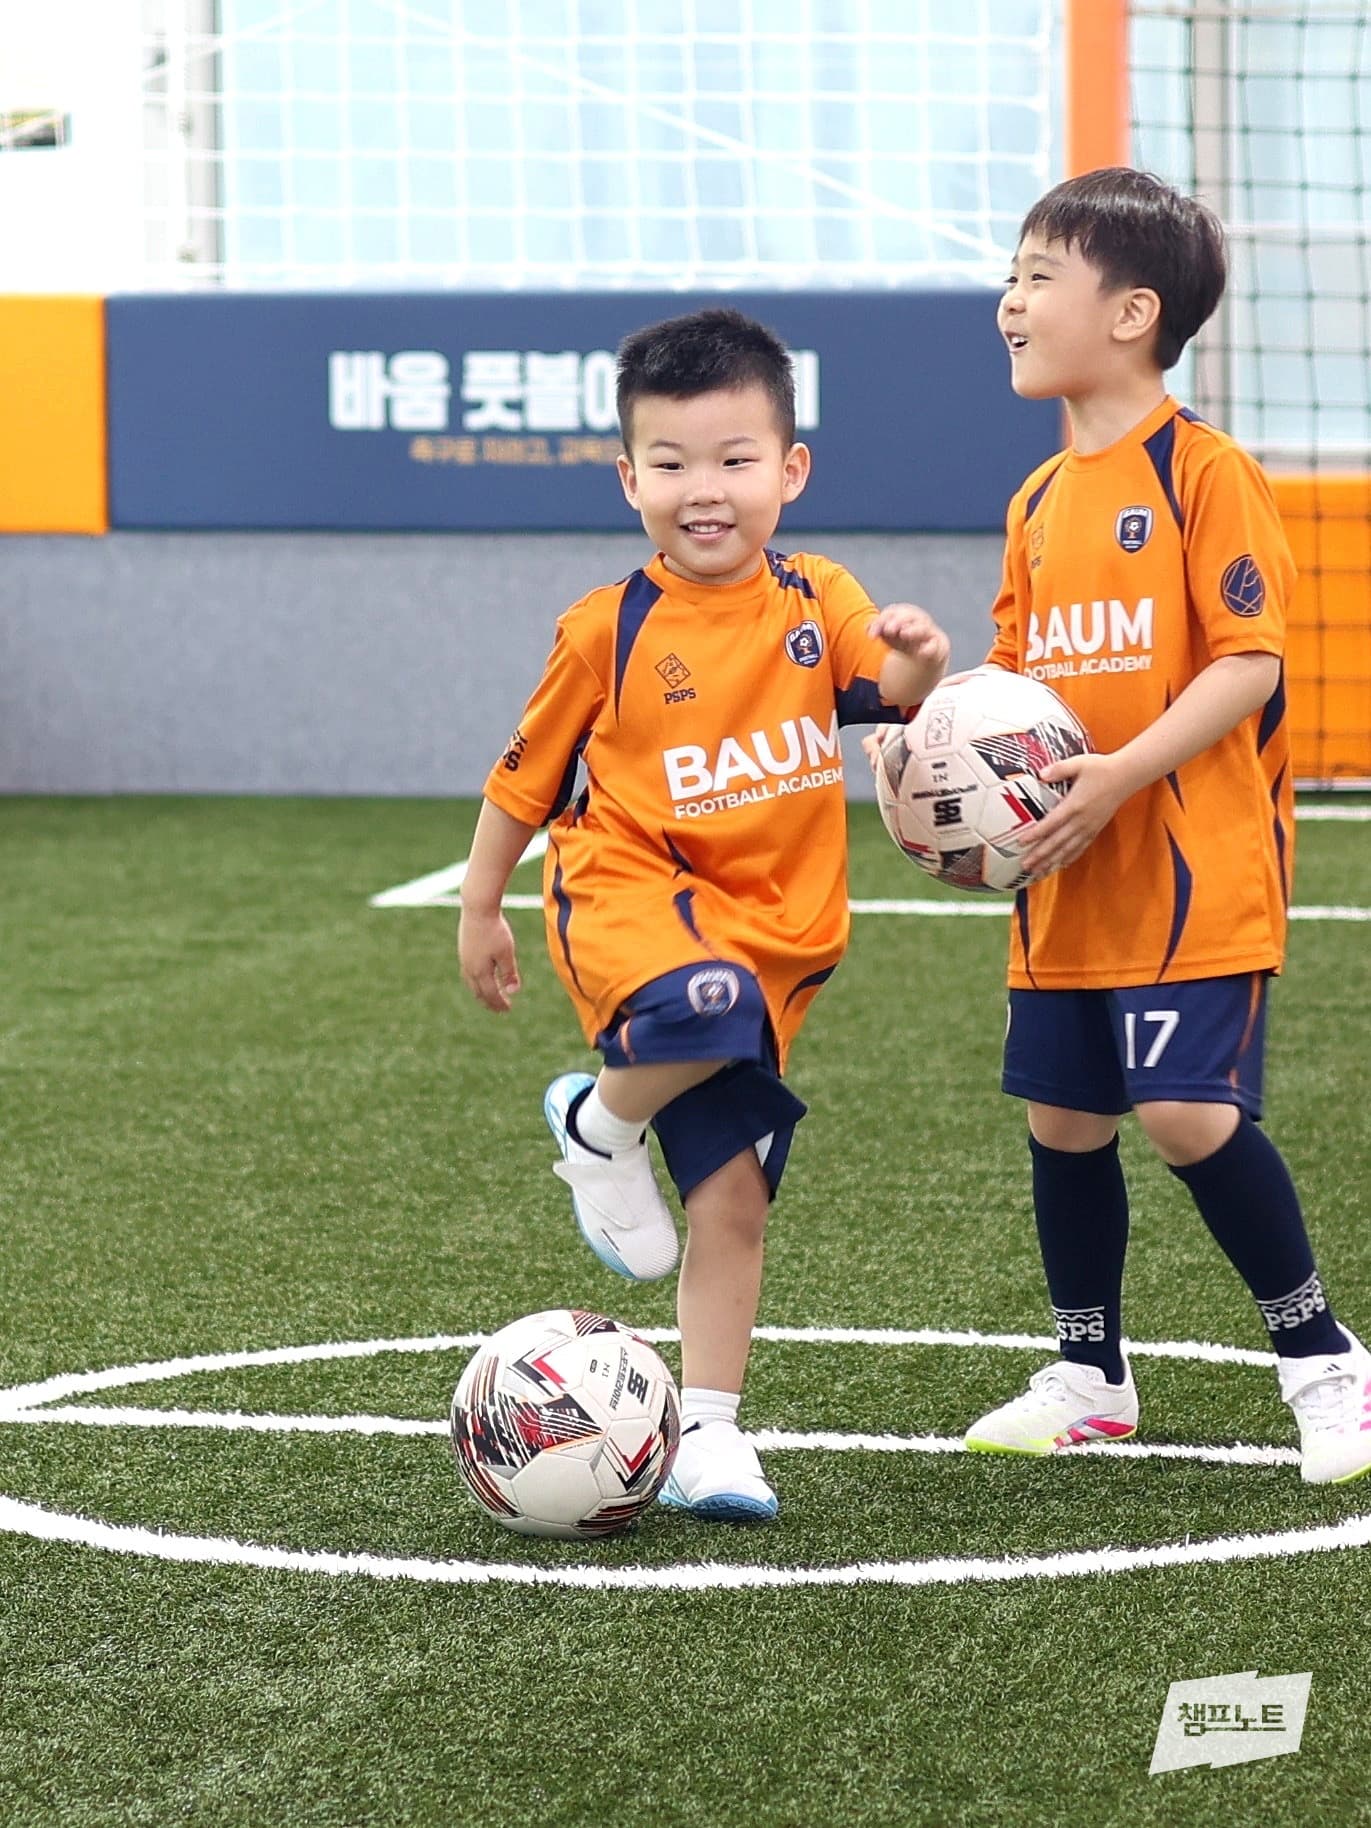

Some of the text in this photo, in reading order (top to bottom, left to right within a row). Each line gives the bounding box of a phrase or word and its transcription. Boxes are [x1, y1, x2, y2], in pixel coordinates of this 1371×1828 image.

[328, 350, 451, 430] 바움
[1026, 597, 1154, 662] BAUM
[664, 688, 697, 704] PSPS
[663, 708, 843, 801] BAUM
[674, 766, 844, 819] FOOTBALL ACADEM
[1124, 1010, 1180, 1069] 17
[1056, 1320, 1105, 1342] SPS
[1264, 1286, 1326, 1332] PSPS
